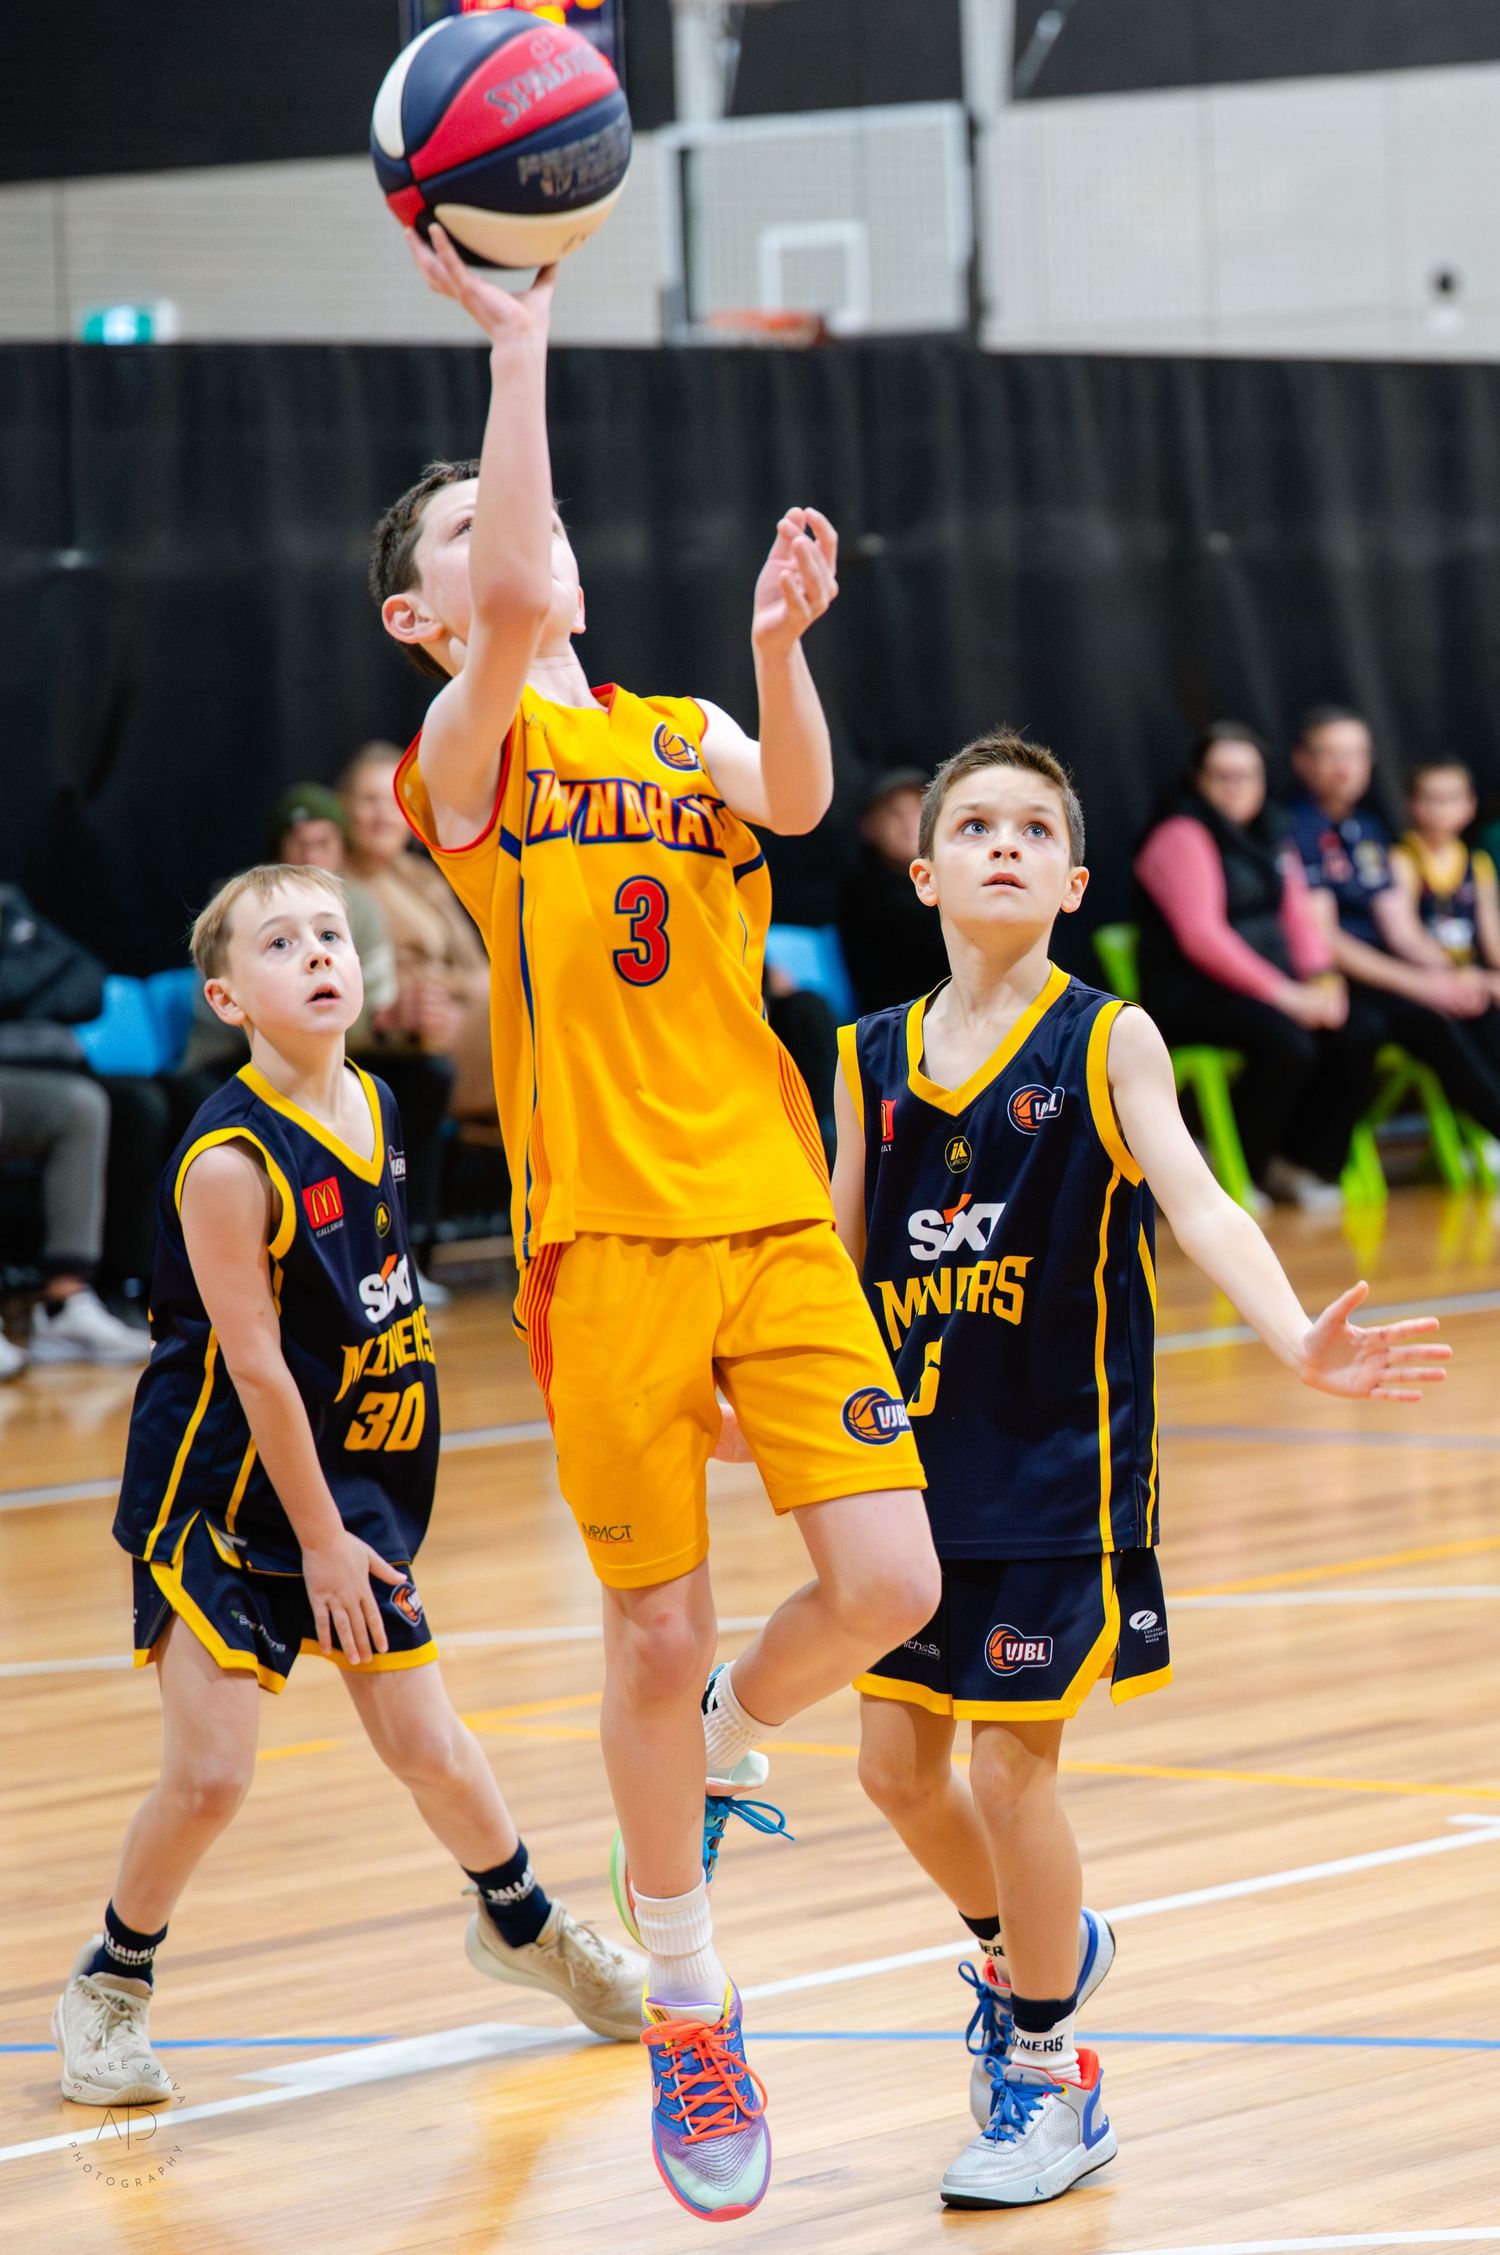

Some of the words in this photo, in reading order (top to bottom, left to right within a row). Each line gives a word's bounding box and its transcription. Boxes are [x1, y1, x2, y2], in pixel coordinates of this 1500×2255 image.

[613, 875, 670, 987] 3
[344, 1381, 425, 1452] 30
[1006, 1642, 1046, 1662] VJBL
